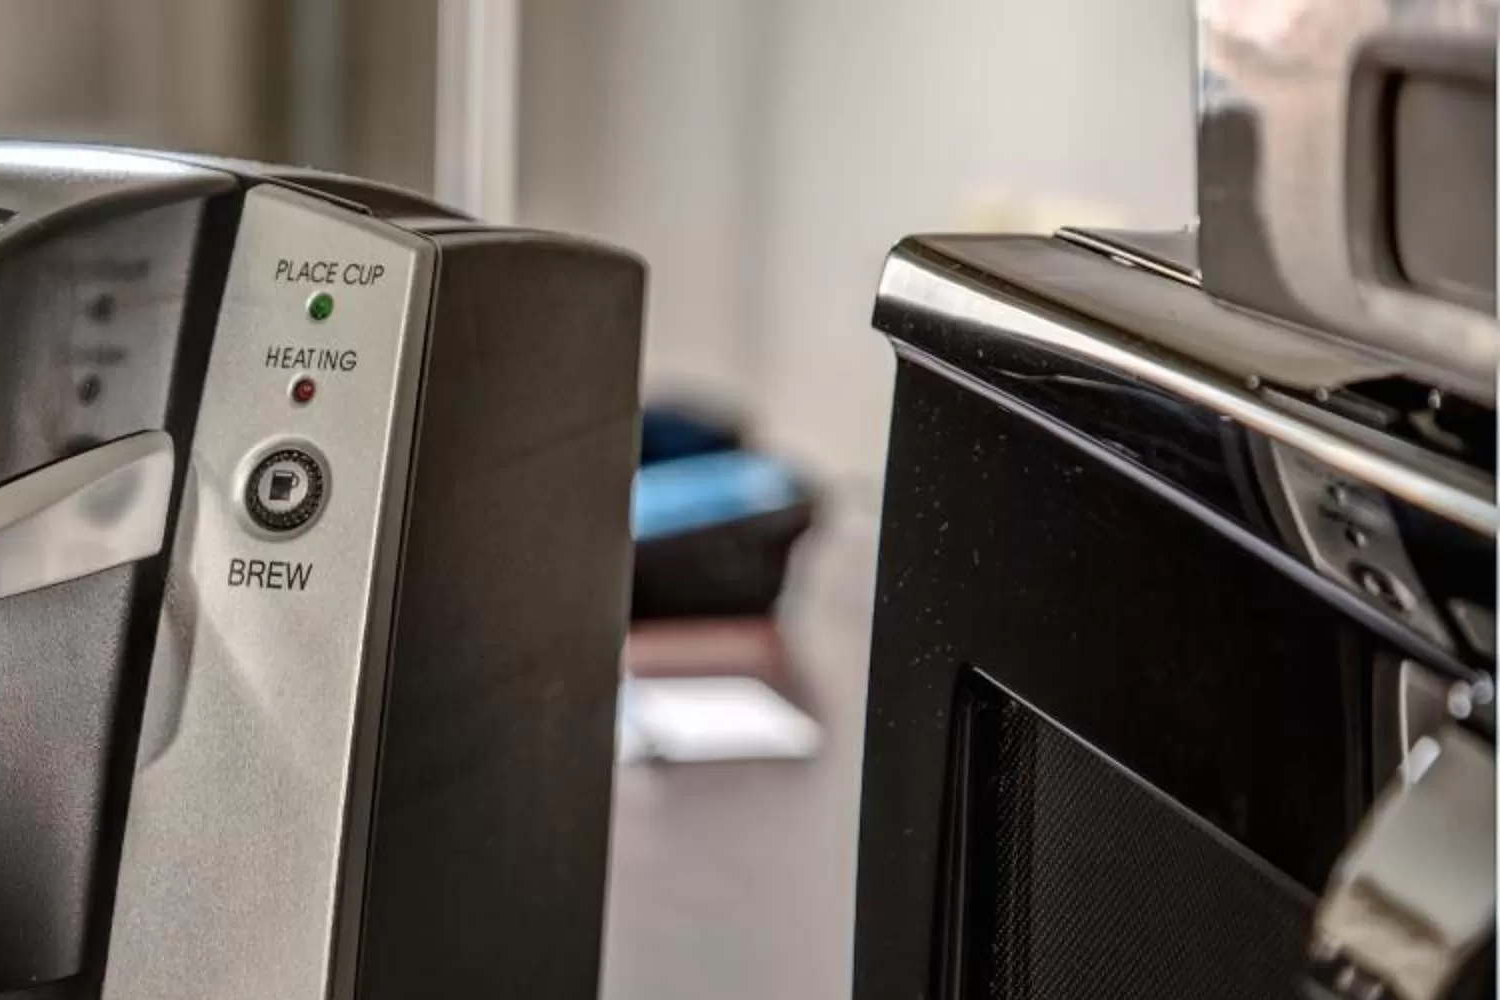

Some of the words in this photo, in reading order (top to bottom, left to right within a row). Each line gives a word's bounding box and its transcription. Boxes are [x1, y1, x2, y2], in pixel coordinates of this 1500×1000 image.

[275, 259, 339, 284] PLACE
[343, 263, 385, 285] CUP
[265, 346, 357, 372] HEATING
[228, 558, 313, 591] BREW
